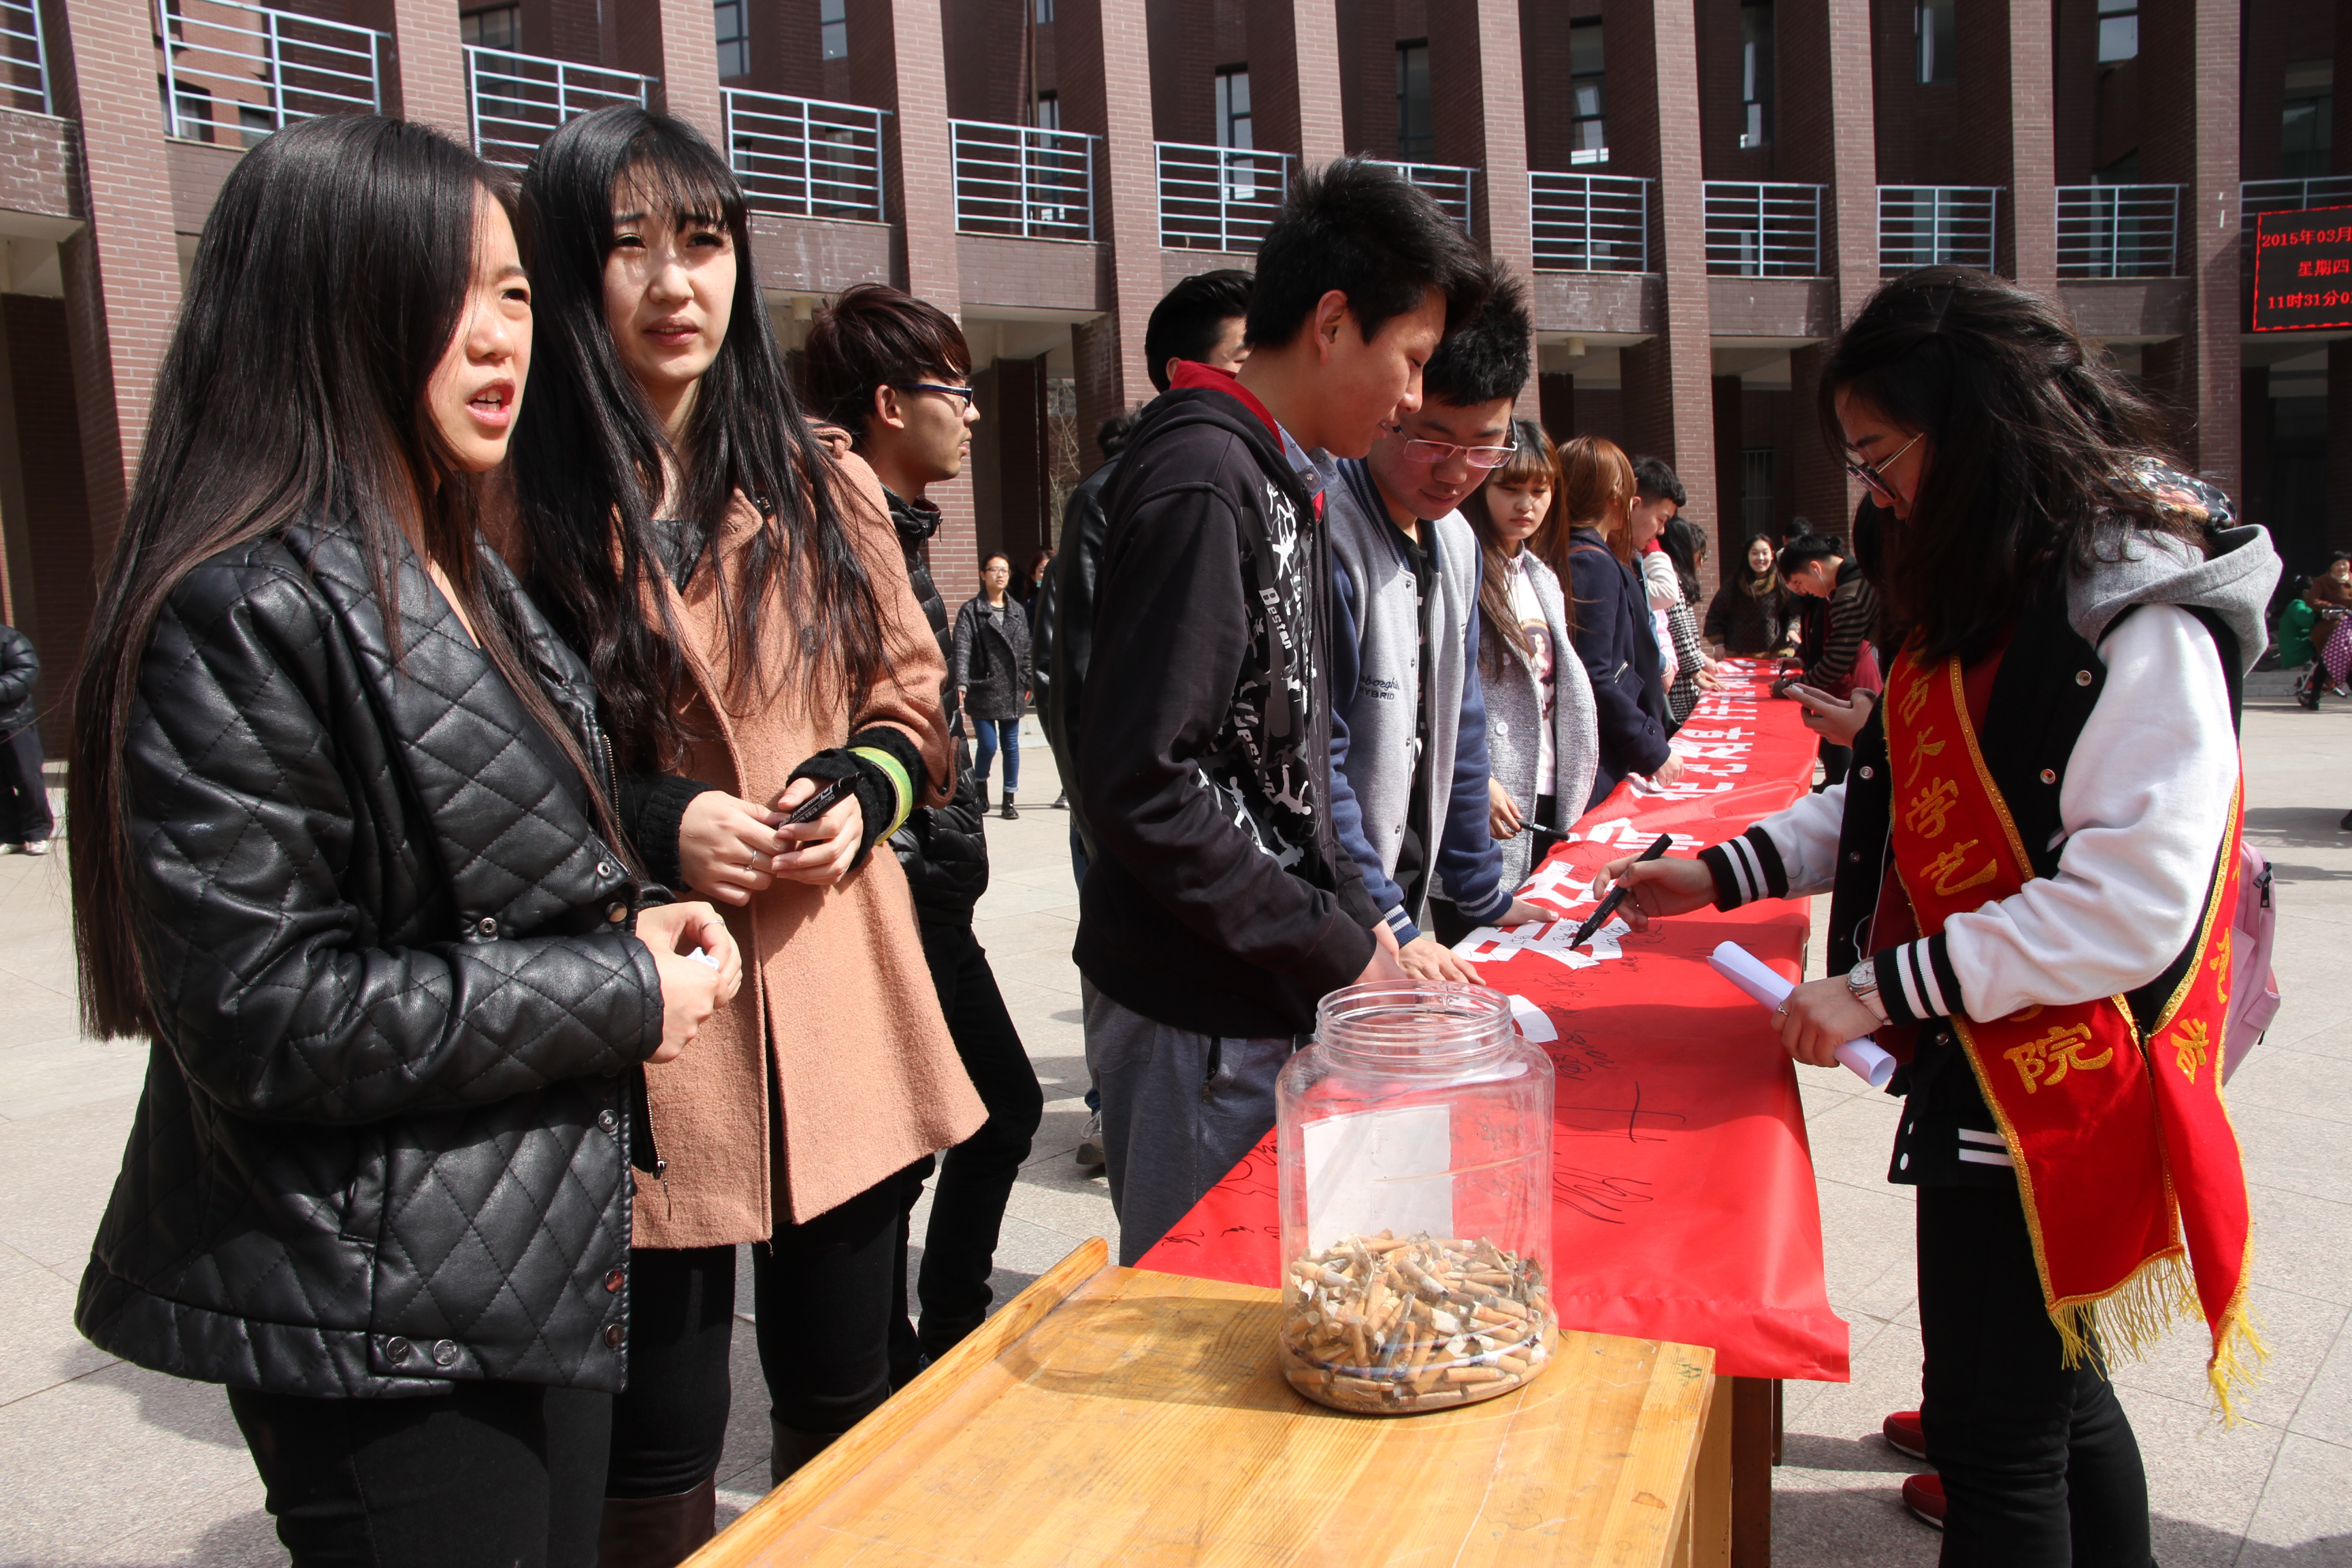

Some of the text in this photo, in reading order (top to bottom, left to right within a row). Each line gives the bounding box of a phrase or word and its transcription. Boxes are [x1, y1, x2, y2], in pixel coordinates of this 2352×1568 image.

[2261, 227, 2352, 247] 2015年03月
[2298, 259, 2350, 276] 星期四
[1359, 687, 1394, 700] HYBRID
